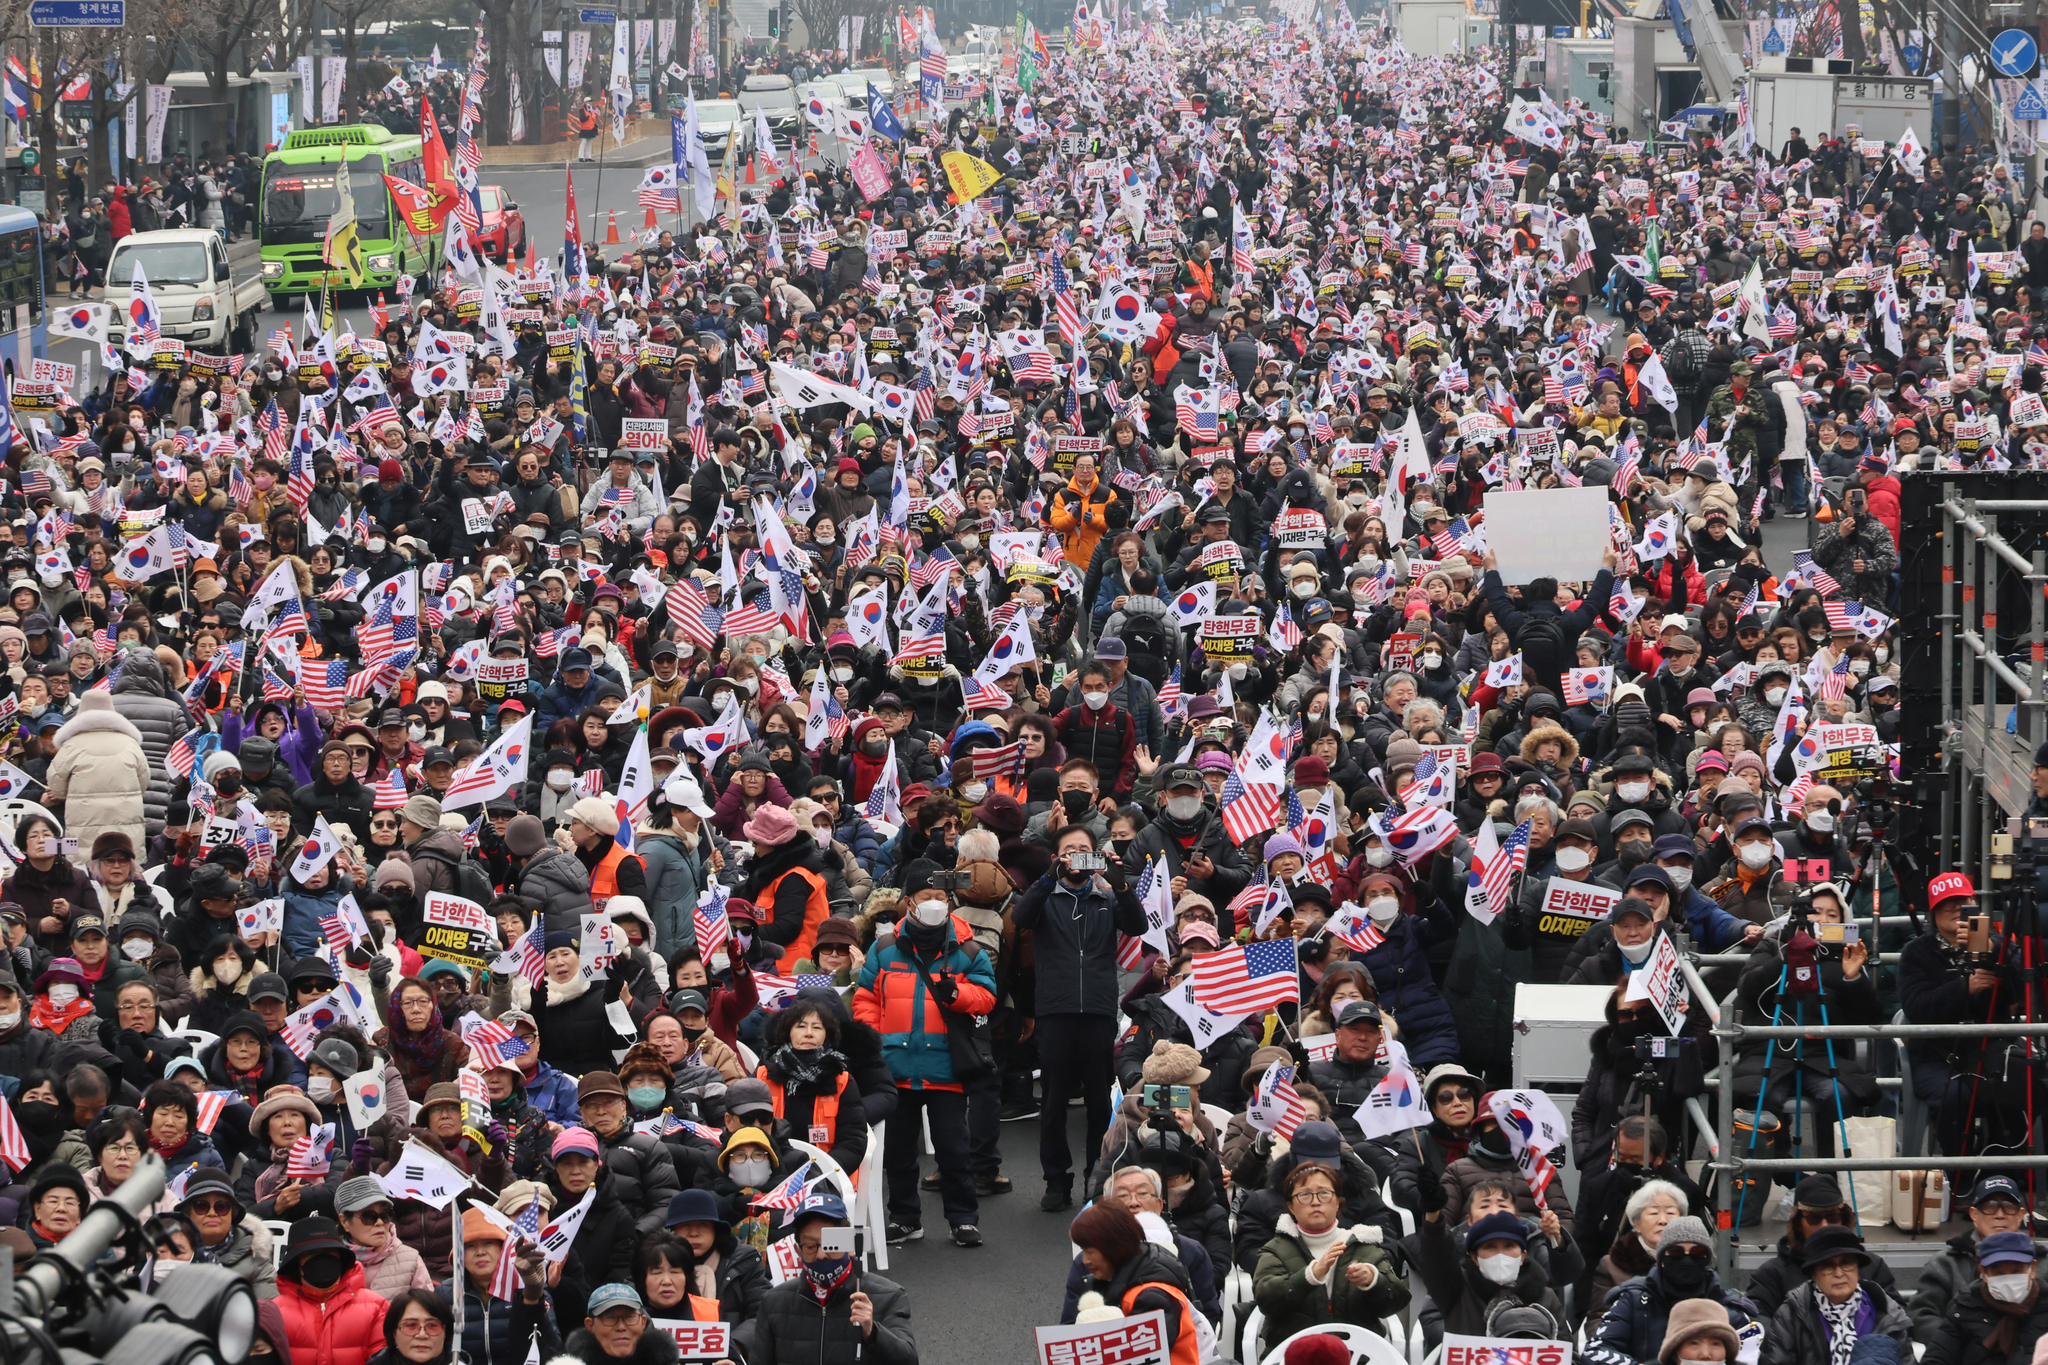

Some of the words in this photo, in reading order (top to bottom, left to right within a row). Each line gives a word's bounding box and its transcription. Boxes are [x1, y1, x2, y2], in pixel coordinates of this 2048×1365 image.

[78, 3, 120, 15] 청계천로
[34, 361, 74, 388] 청주3호차
[15, 382, 55, 394] 탄핵무효
[626, 421, 664, 432] 선관위서버
[984, 412, 1013, 428] 핵무효
[626, 432, 663, 449] 열어!
[1058, 439, 1101, 450] 탄핵무효
[1057, 452, 1077, 463] 이재
[908, 499, 932, 513] 무효
[1281, 514, 1325, 530] 탄핵무효
[1205, 618, 1257, 635] 탄핵무효
[1203, 637, 1236, 652] 이재명
[1235, 636, 1255, 650] 구속
[478, 662, 527, 682] 탄핵무효
[506, 681, 528, 694] 구속
[206, 825, 236, 844] 조기
[1932, 877, 1963, 896] 0010
[425, 925, 470, 950] 이재명
[430, 948, 448, 961] STOP
[448, 952, 461, 964] THE
[658, 1327, 725, 1356] 무효
[1049, 1324, 1157, 1365] 불법구속
